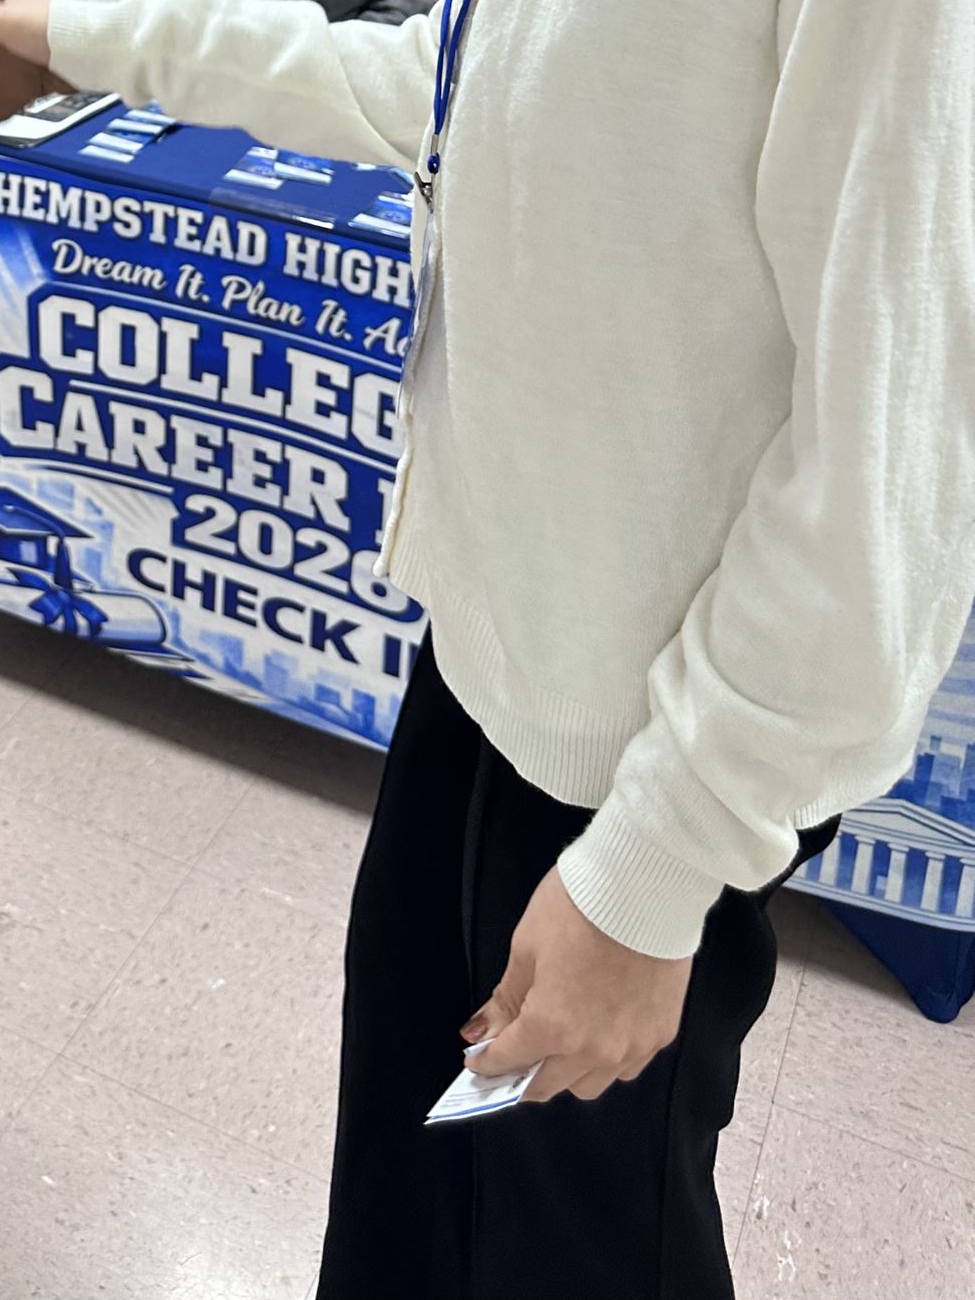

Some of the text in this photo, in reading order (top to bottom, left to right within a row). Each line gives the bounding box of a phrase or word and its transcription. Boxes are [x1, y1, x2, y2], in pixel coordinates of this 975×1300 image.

[51, 238, 167, 291] Dream
[176, 263, 211, 303] It.
[221, 275, 306, 327] Plan
[315, 299, 353, 342] It.
[283, 231, 410, 308] HIGH
[127, 547, 362, 666] CHECK
[184, 493, 409, 614] 2026
